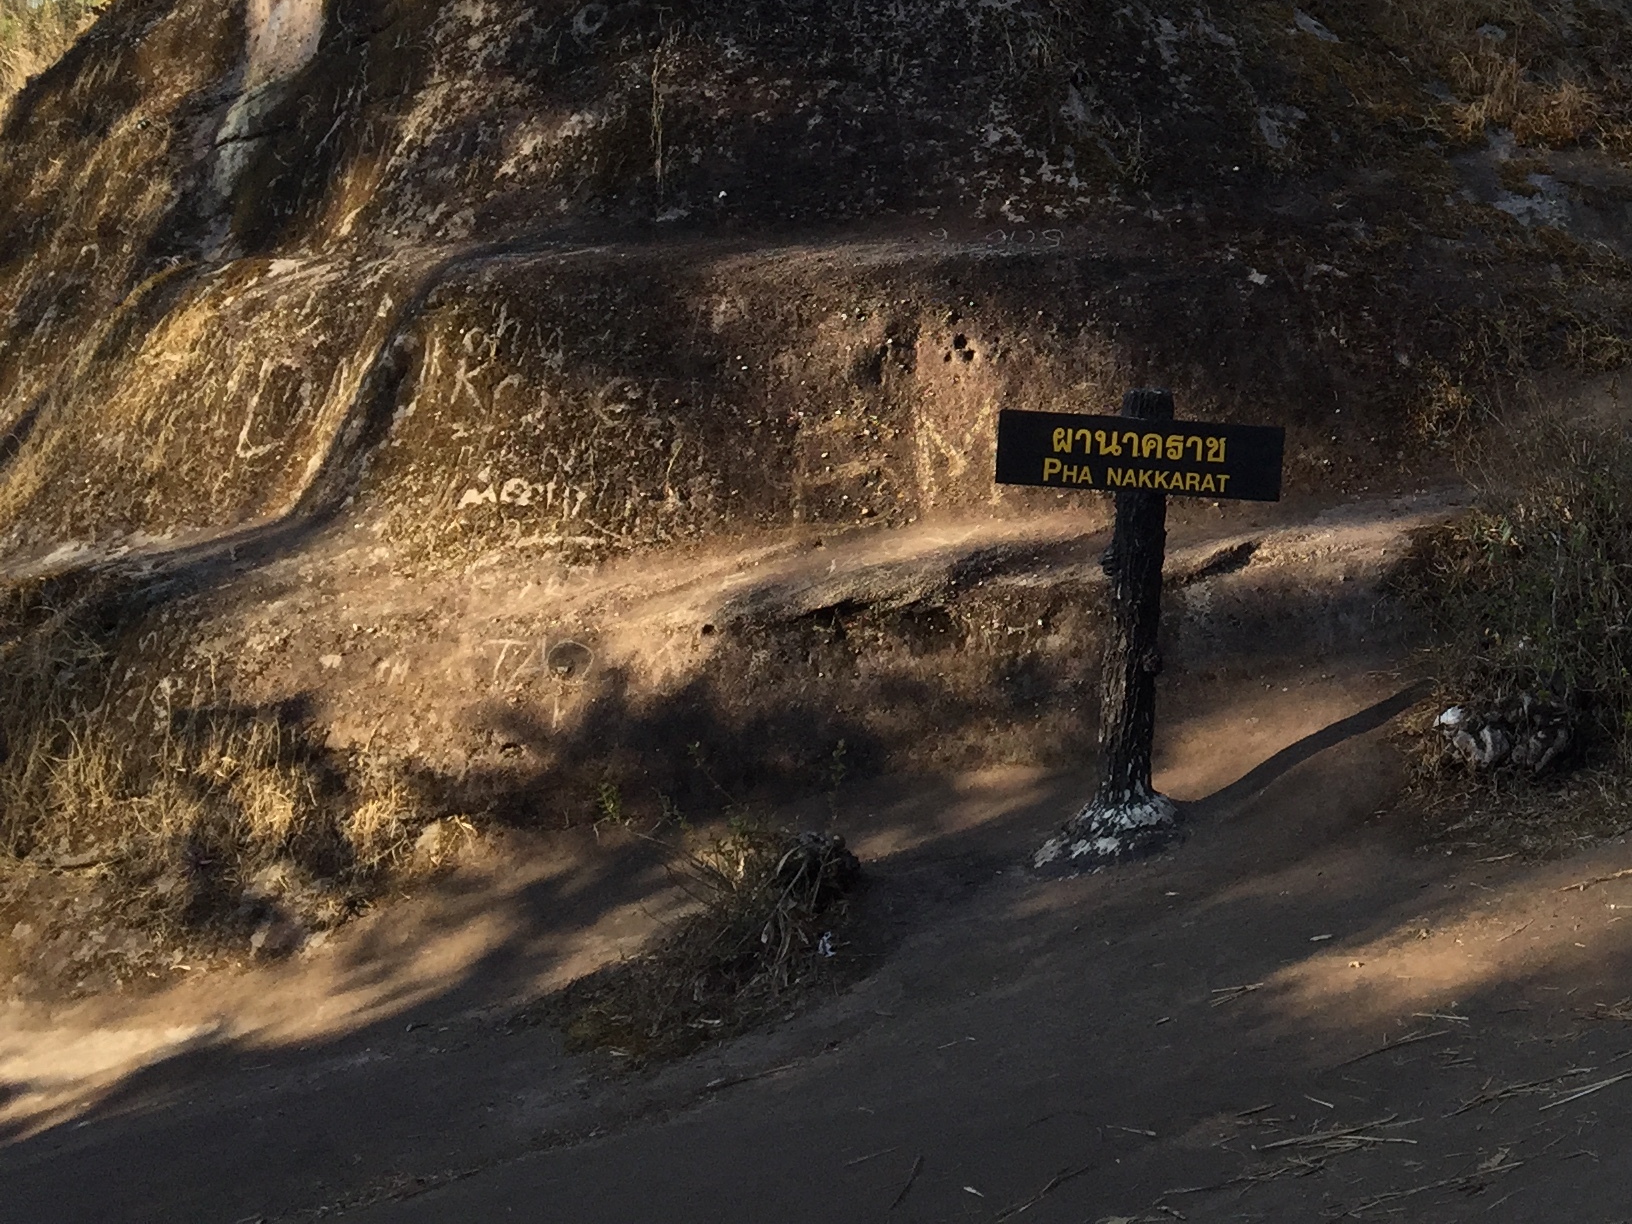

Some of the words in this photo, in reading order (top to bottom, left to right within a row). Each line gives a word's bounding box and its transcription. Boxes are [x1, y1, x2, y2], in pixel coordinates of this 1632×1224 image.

[1052, 427, 1227, 463] ผานาคราช
[1042, 458, 1093, 485] PHA
[1106, 467, 1231, 493] NAKKARAT
